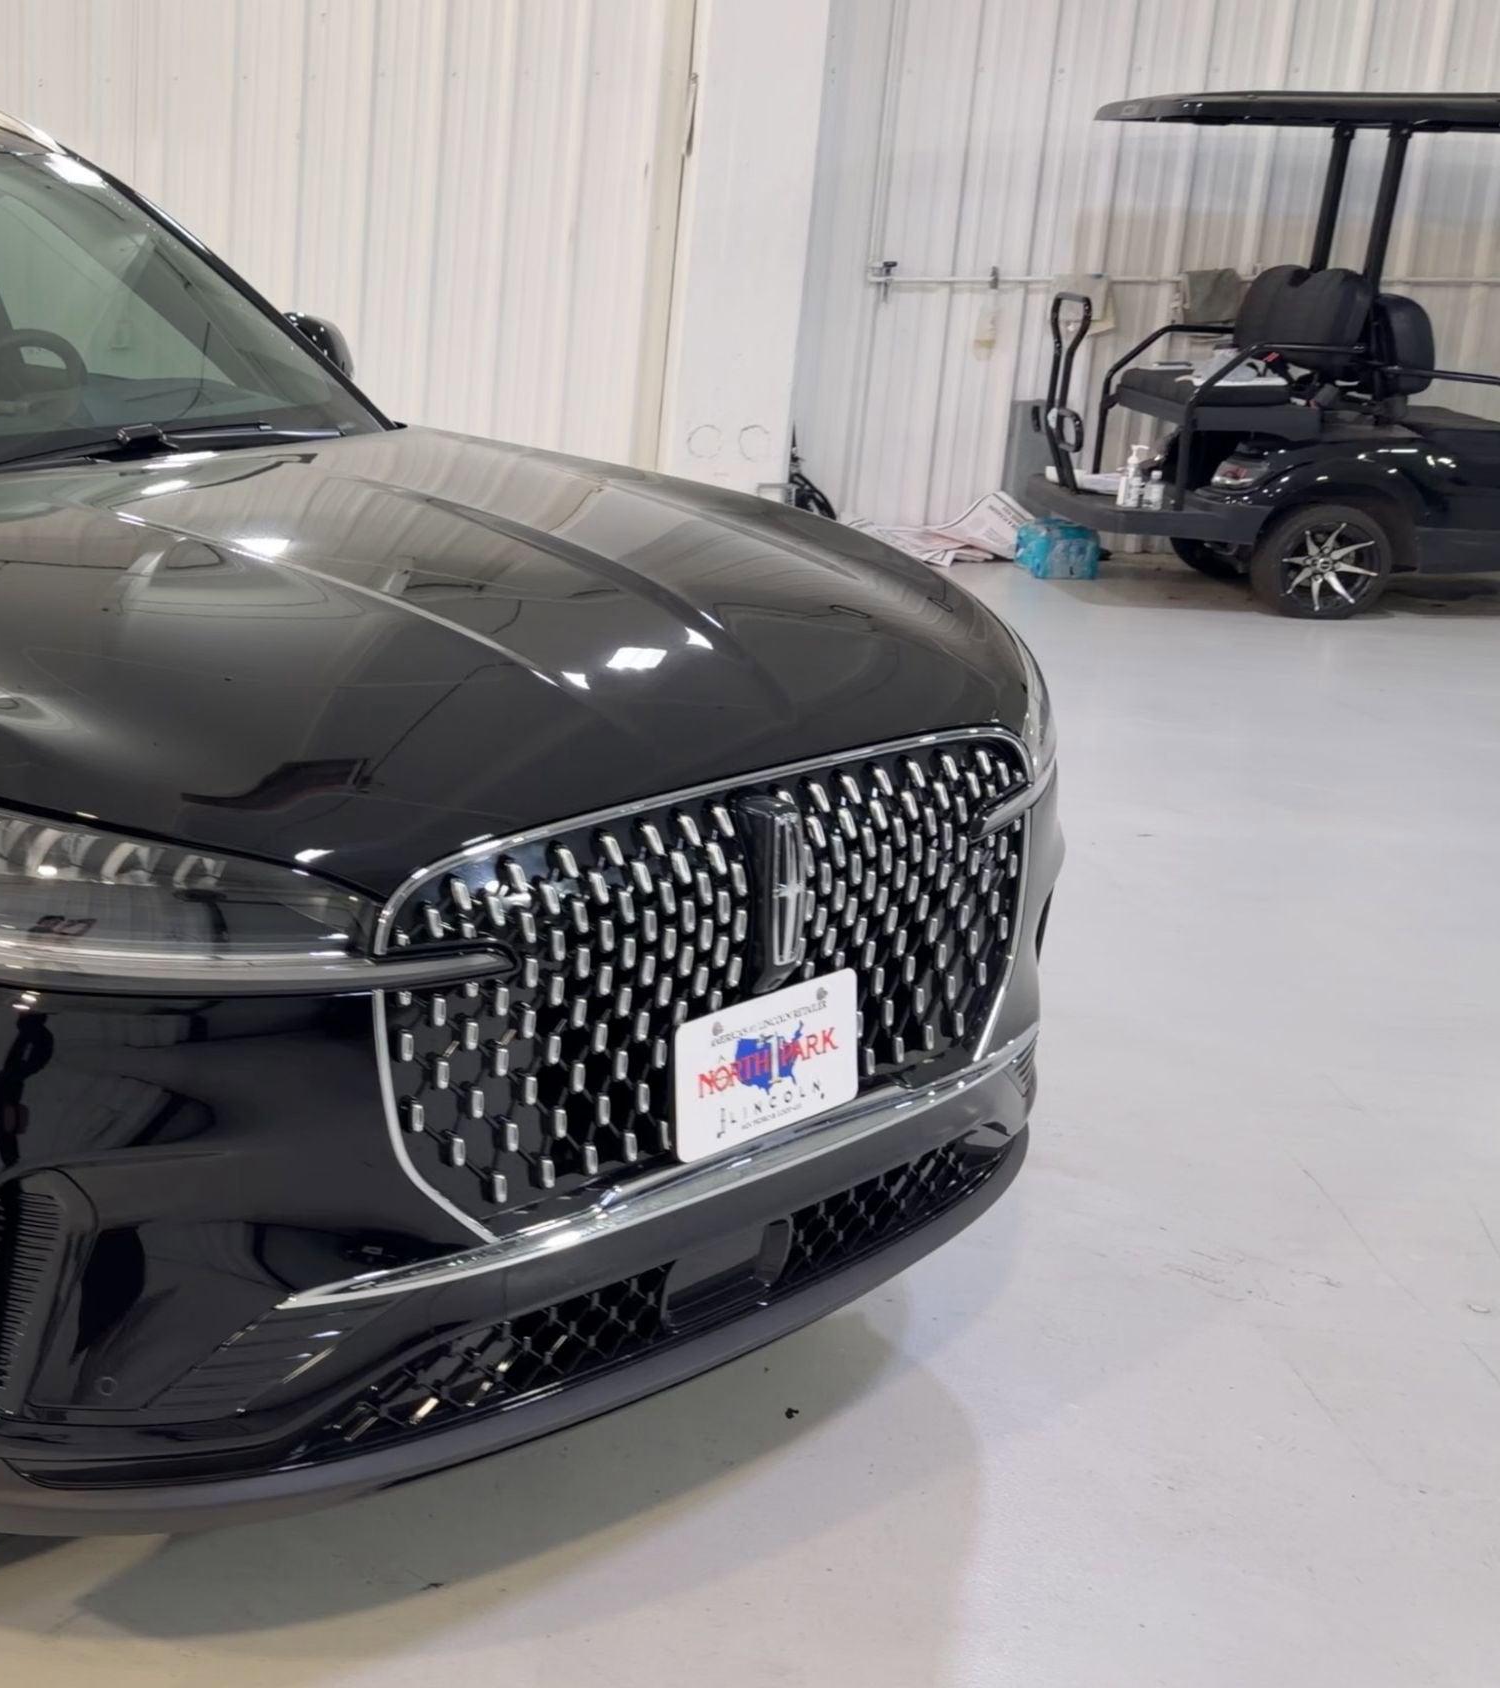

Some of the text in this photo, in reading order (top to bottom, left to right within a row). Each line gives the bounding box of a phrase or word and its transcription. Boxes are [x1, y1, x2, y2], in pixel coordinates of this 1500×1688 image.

[698, 1026, 839, 1099] NORTH PARK
[729, 1081, 821, 1123] LINCOLN
